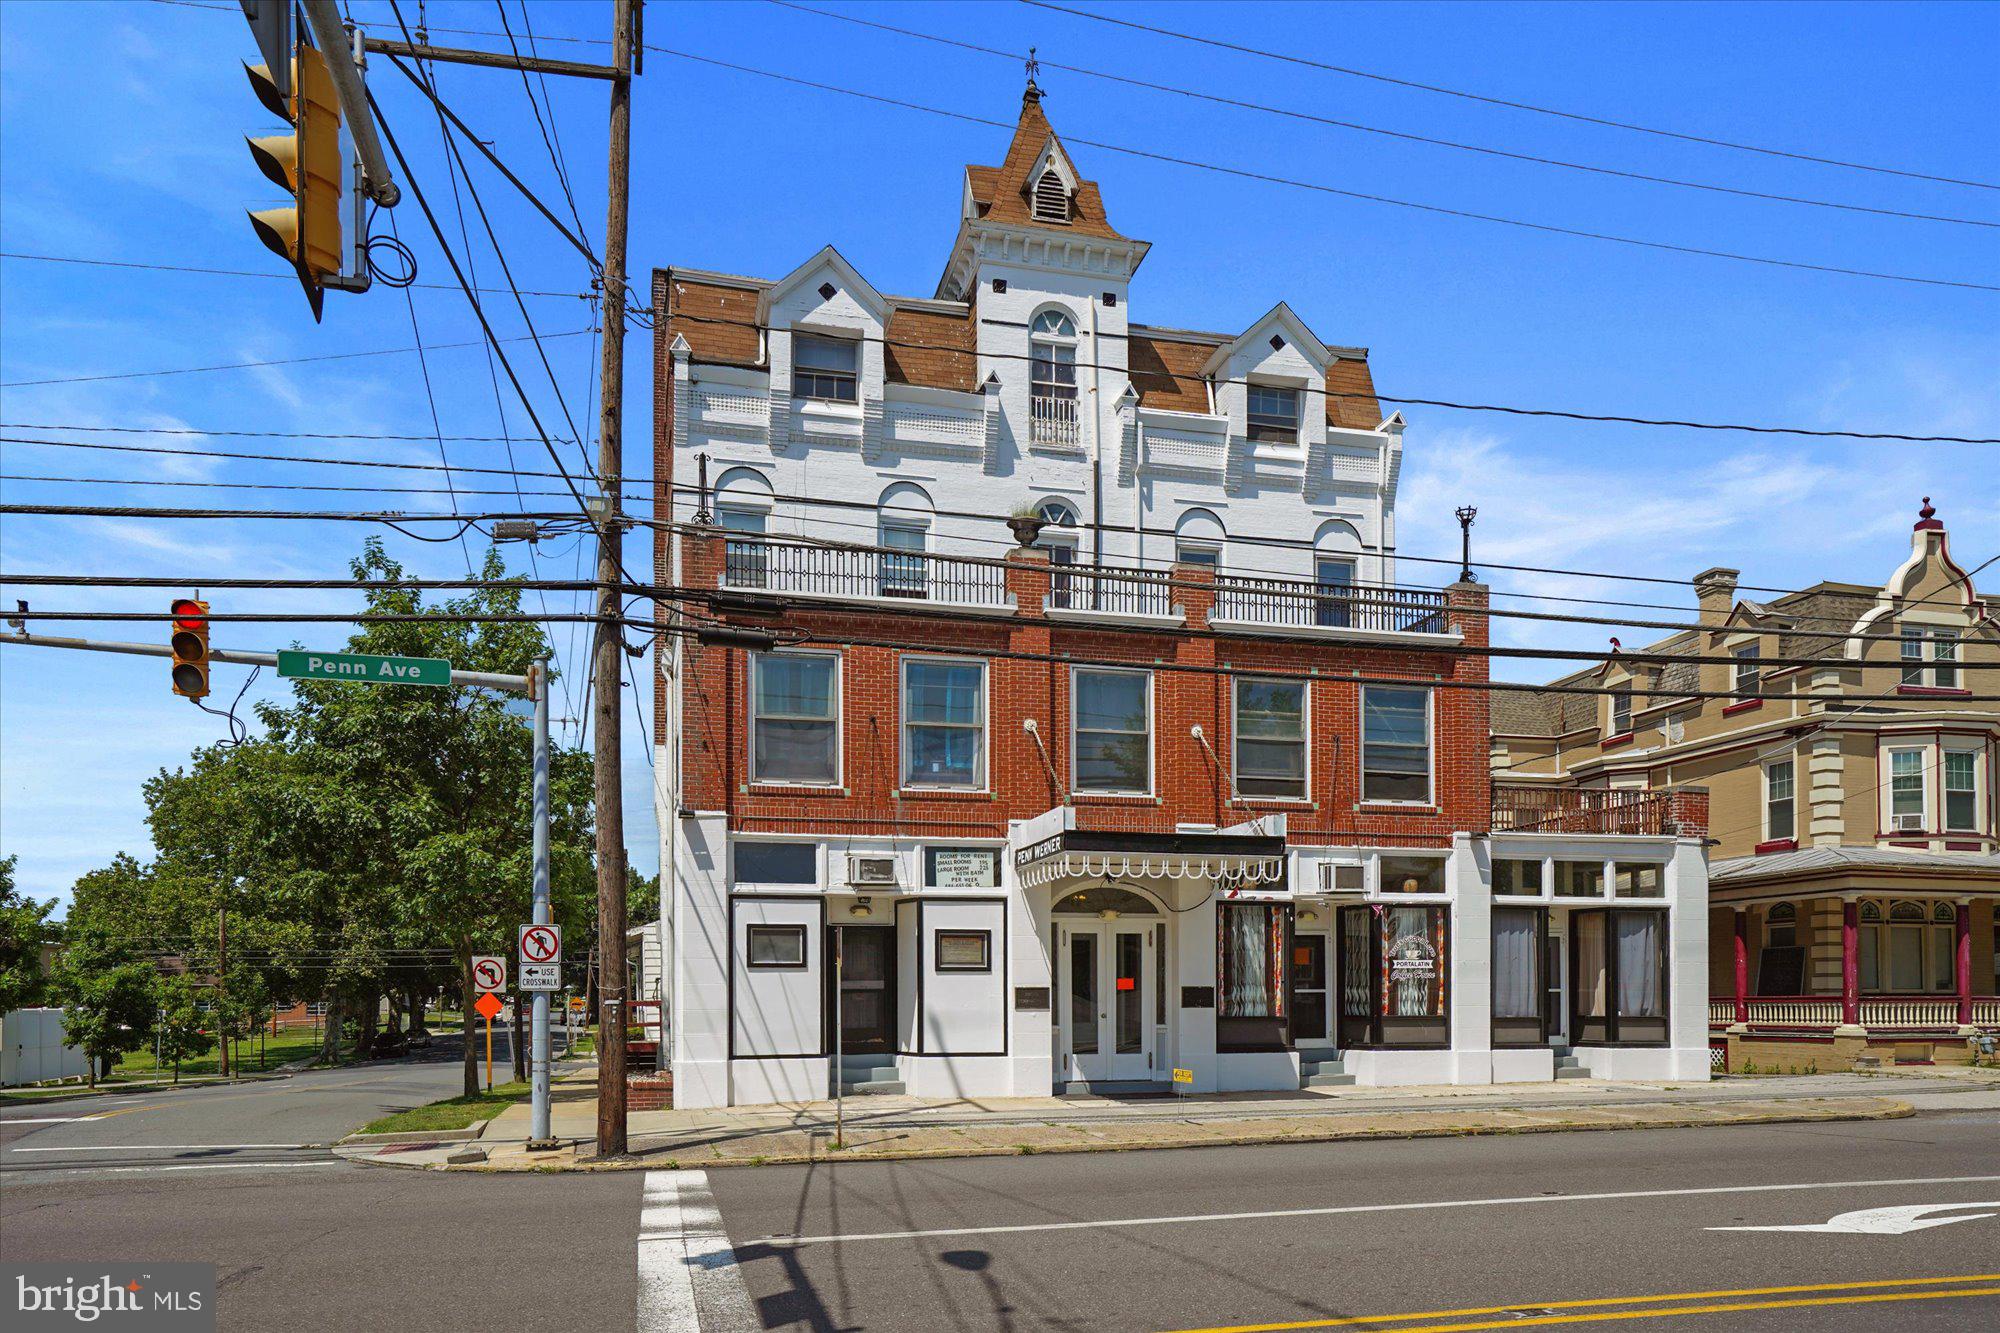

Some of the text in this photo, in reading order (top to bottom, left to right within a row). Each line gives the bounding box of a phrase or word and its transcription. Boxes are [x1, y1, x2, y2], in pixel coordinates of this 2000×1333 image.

[308, 657, 421, 678] Penn Ave
[1034, 836, 1061, 859] WERNER
[522, 978, 558, 986] CROSSWALK
